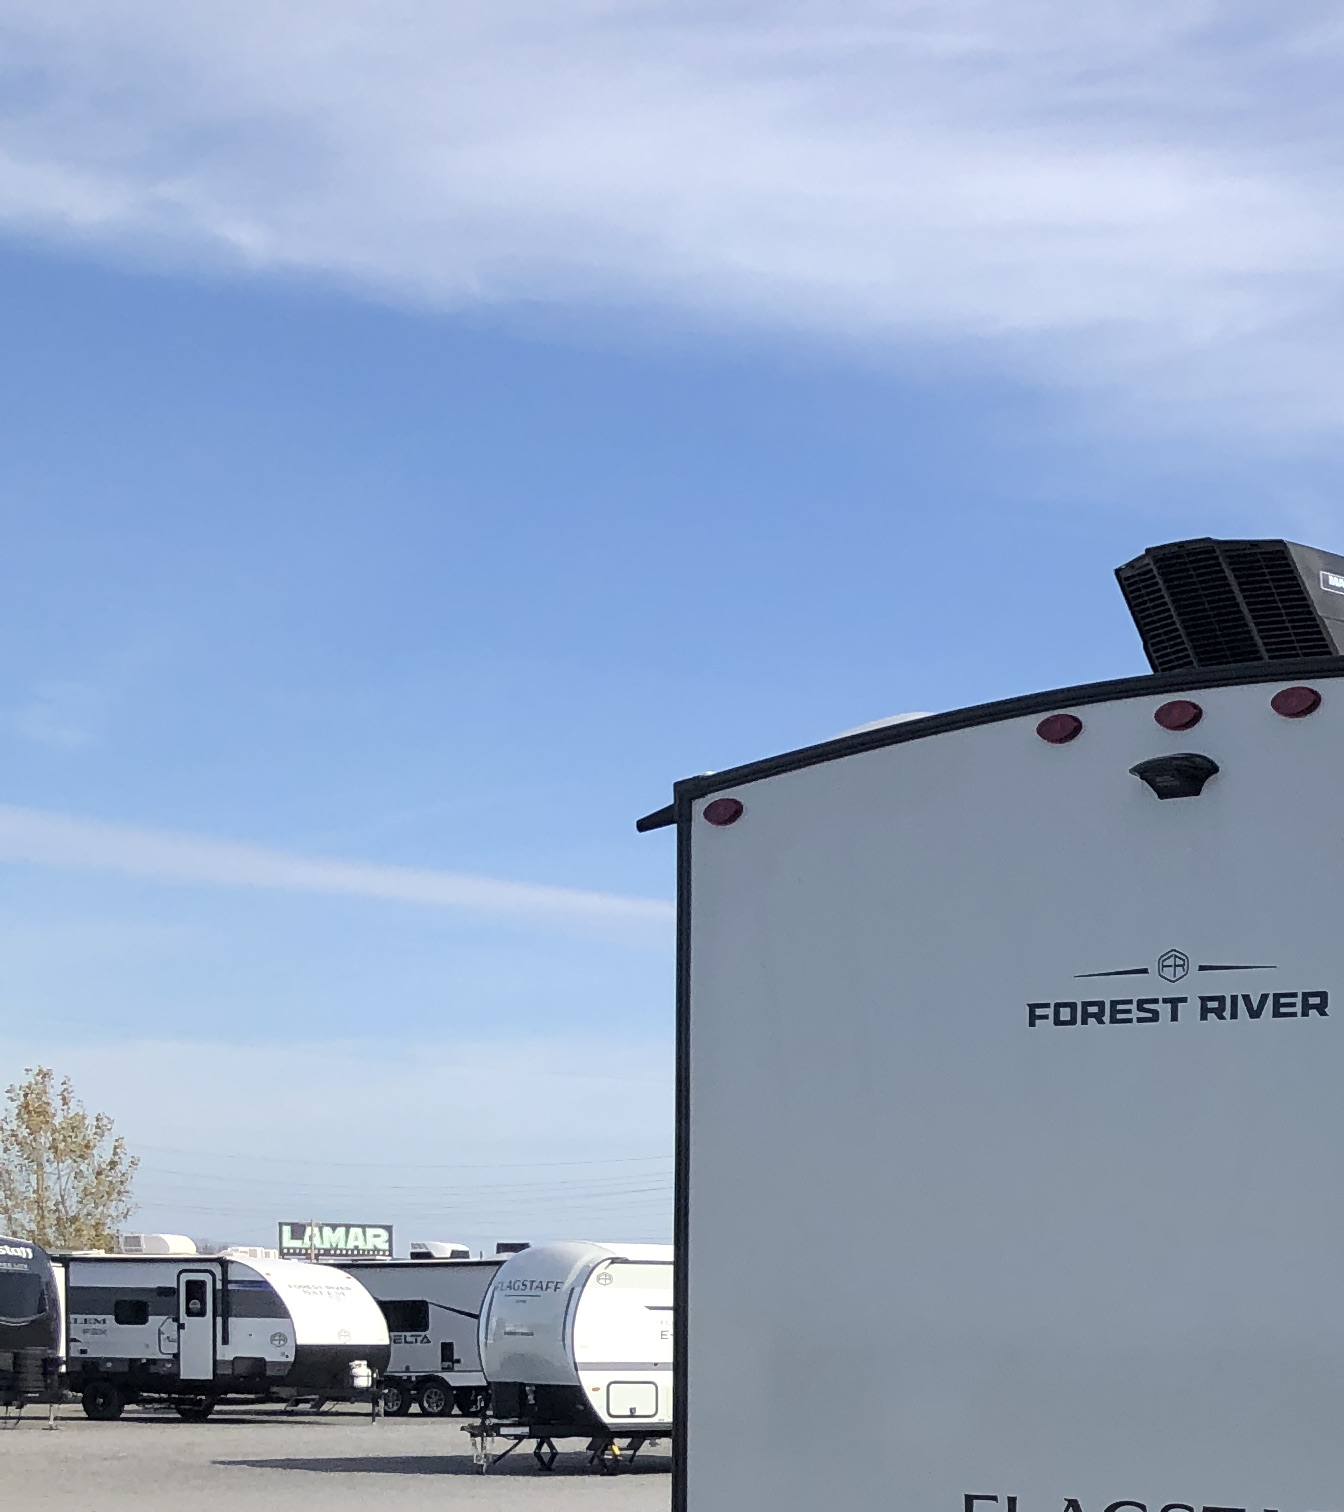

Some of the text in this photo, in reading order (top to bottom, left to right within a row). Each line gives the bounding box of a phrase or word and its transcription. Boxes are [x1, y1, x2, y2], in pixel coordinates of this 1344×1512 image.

[1026, 990, 1330, 1028] FOREST RIVER
[281, 1224, 390, 1251] LAMAR
[495, 1279, 565, 1293] FLAGSTAFF
[392, 1333, 432, 1345] ELTA
